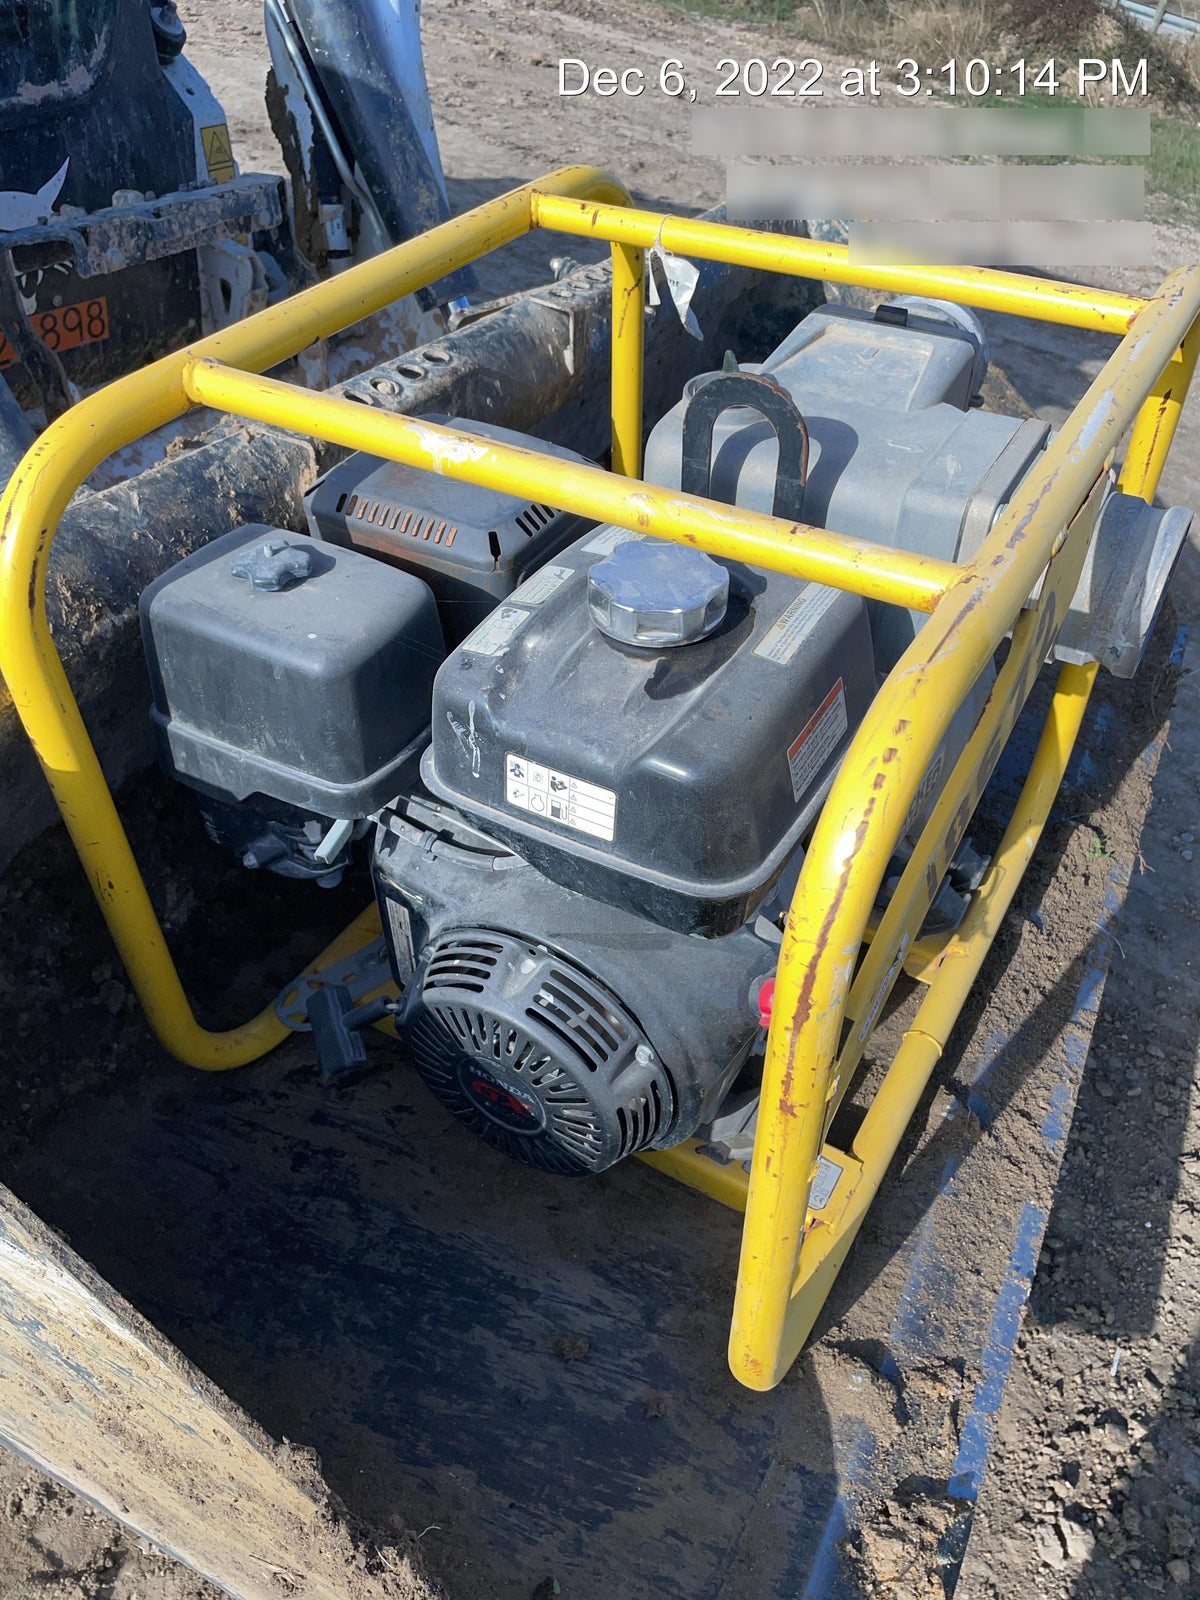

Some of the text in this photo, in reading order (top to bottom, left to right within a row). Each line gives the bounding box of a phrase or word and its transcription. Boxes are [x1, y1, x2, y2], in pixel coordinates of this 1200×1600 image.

[781, 597, 807, 625] WARNING
[469, 1065, 535, 1104] HONDA
[472, 1080, 533, 1118] GX
